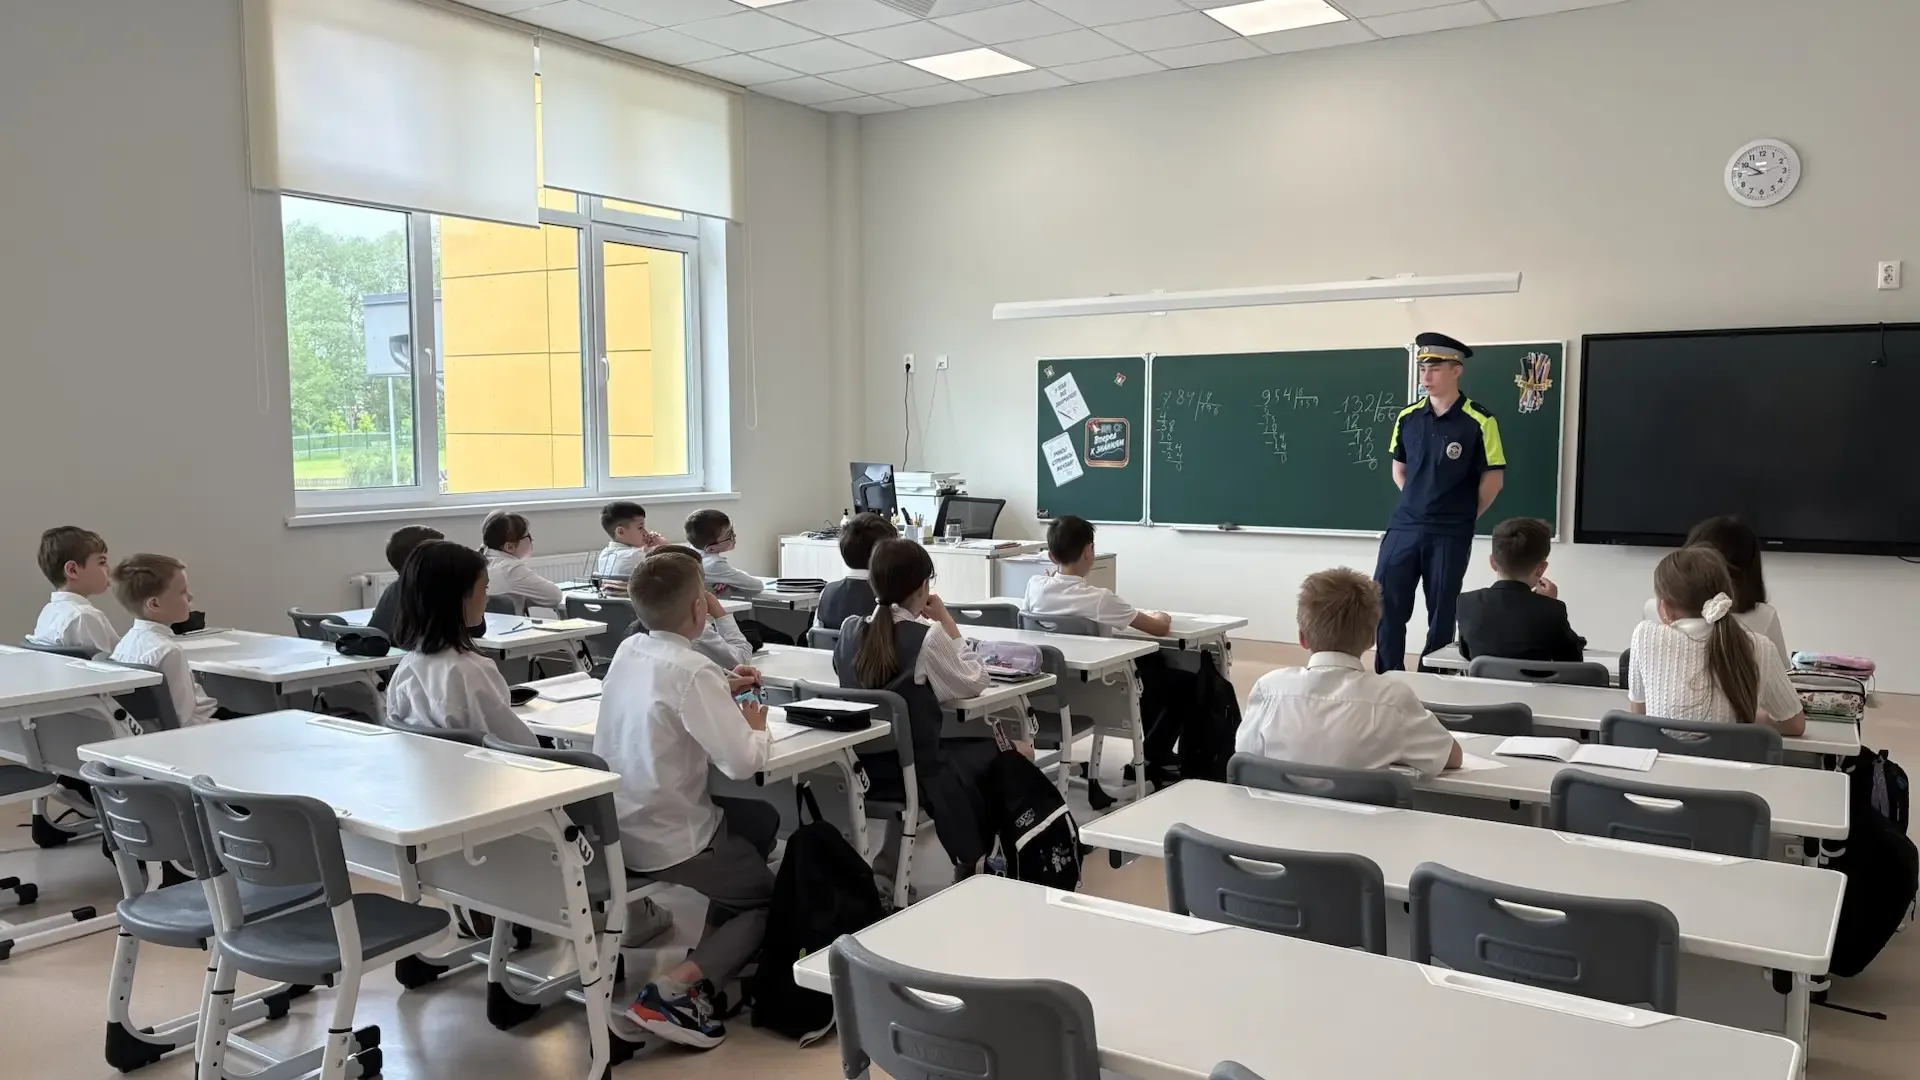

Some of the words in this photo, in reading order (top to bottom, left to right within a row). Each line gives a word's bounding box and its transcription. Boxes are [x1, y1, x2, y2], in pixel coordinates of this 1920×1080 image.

[1261, 387, 1293, 406] 954
[1341, 393, 1375, 413] 132
[1384, 392, 1394, 404] 2
[1345, 413, 1361, 430] 12
[1377, 407, 1396, 422] 66
[1354, 427, 1373, 444] 12
[1357, 442, 1374, 461] 12
